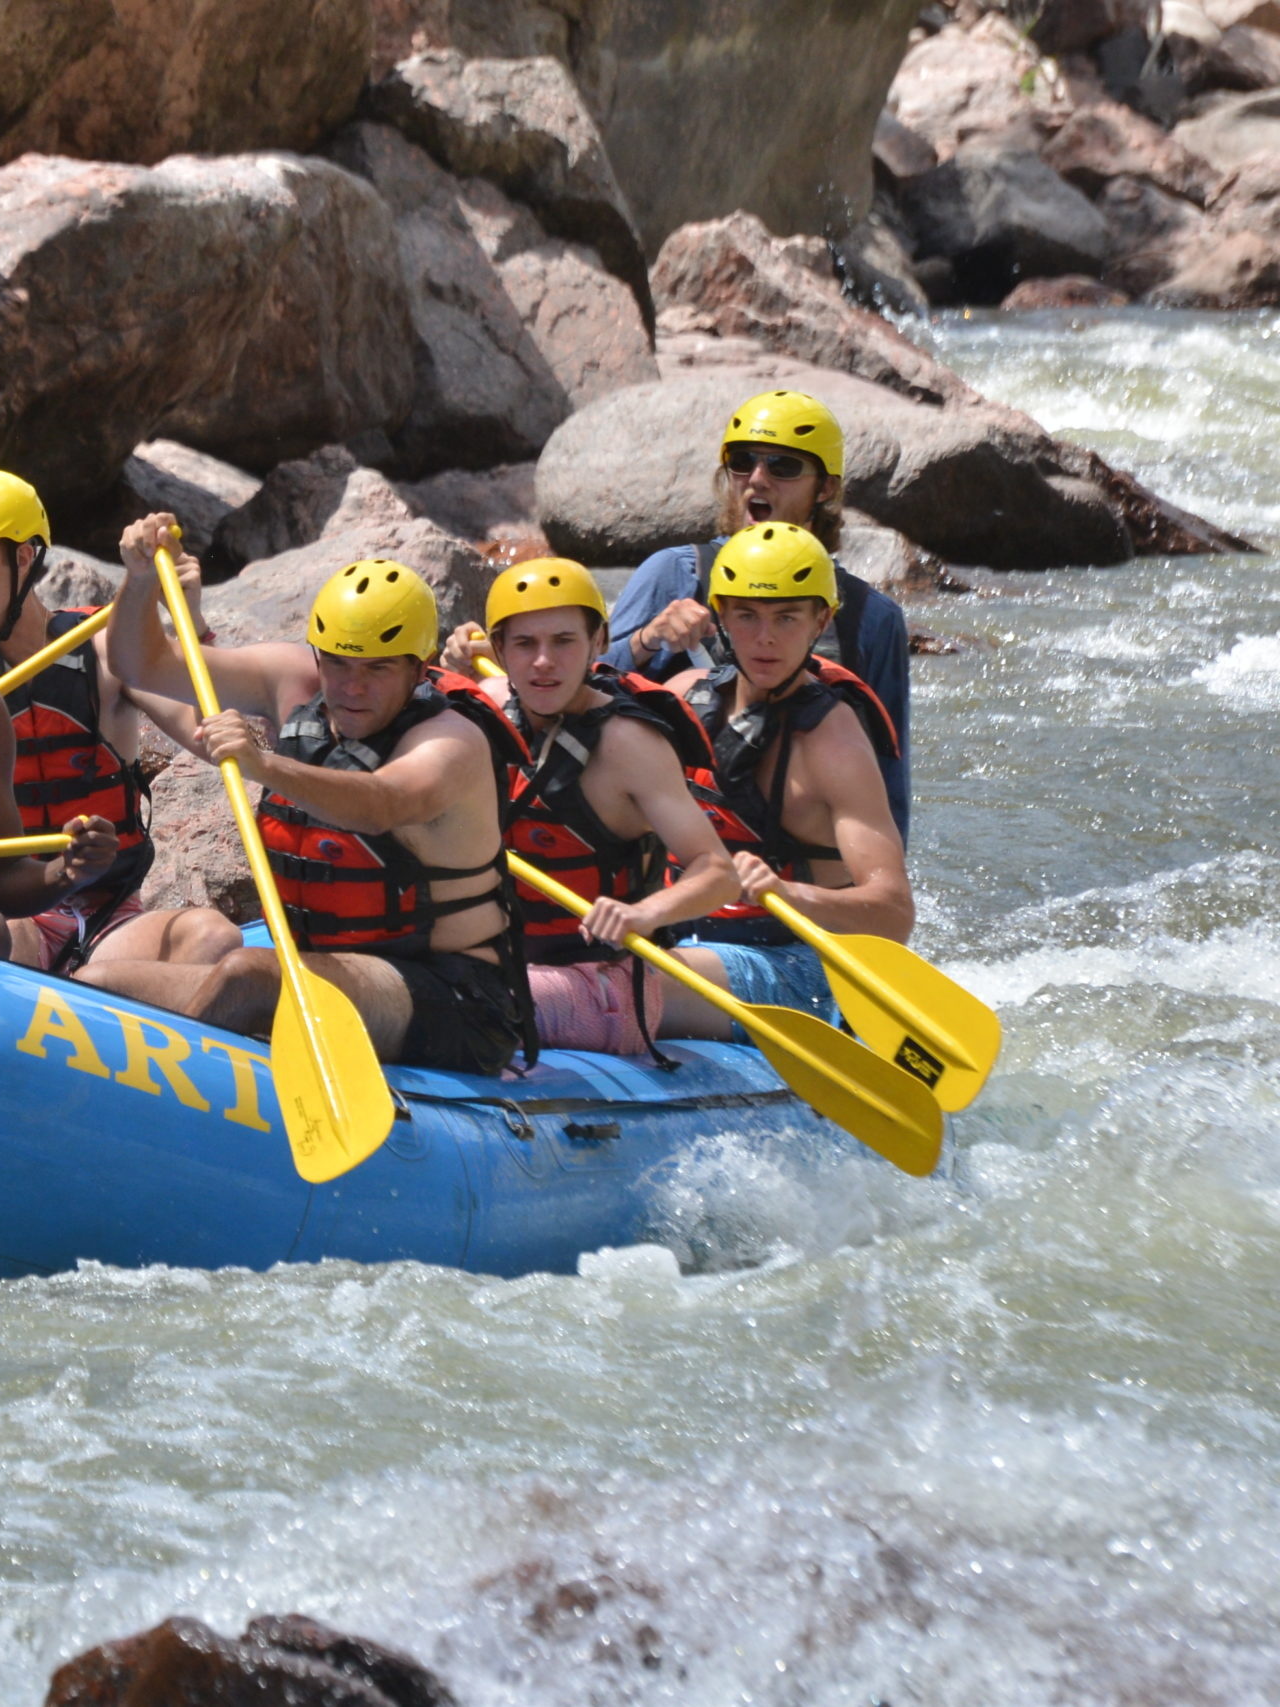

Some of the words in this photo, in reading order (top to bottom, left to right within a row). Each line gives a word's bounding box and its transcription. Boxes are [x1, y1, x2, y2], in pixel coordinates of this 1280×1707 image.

[749, 428, 777, 438] NRS
[748, 582, 778, 591] NRS
[335, 642, 365, 653] NRS
[16, 986, 271, 1133] ART
